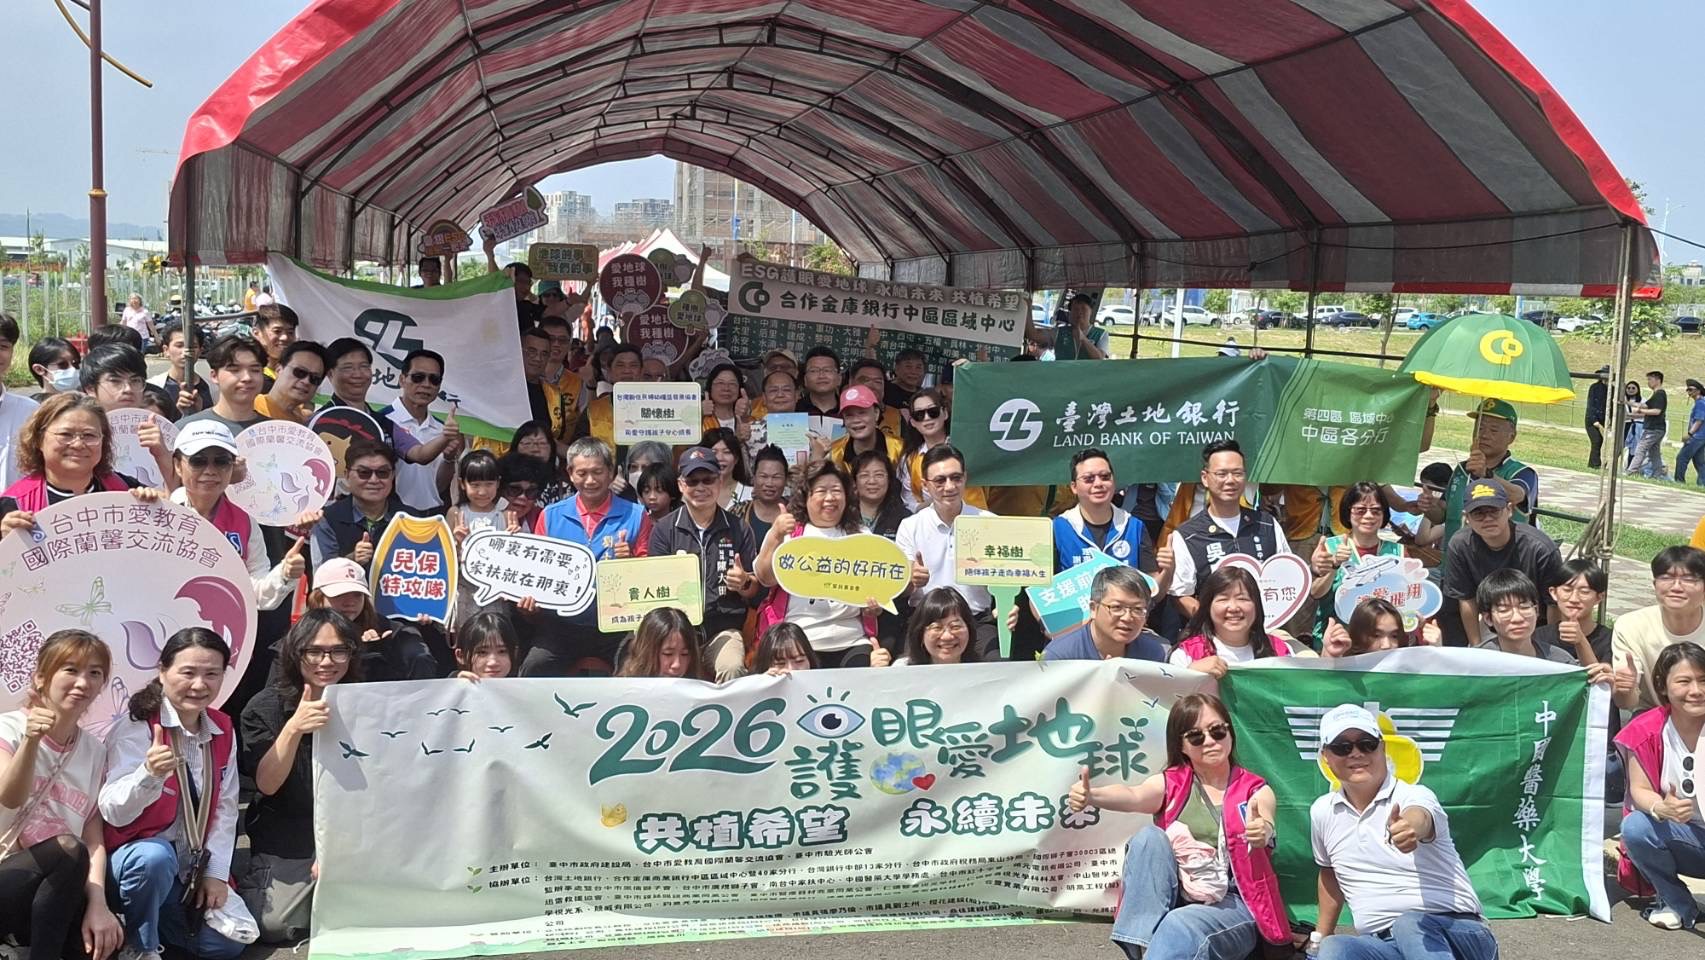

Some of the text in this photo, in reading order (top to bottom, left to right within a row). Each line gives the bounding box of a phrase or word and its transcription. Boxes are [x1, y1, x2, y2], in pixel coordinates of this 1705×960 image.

[611, 262, 646, 274] 愛地球
[612, 276, 647, 288] 我種樹
[740, 264, 1020, 312] ESG護眼愛地球 永續未來 共植希望
[779, 291, 1016, 333] 合作金庫銀行中區區域中心
[640, 327, 675, 339] 我種樹
[1055, 399, 1241, 433] 臺灣土地銀行
[1303, 407, 1343, 423] 第四區
[1053, 431, 1236, 448] LAND BANK OF TAIWAN
[1301, 424, 1390, 446] 中區各分行
[50, 503, 203, 537] 台中市愛教育
[21, 527, 224, 572] 國際蘭馨交流協會
[984, 544, 1024, 558] 幸福樹
[392, 550, 439, 575] 兒保
[778, 552, 906, 580] 做公益的好所在
[964, 568, 1047, 578] 陪伴孩子走向幸福人生
[380, 576, 446, 600] 特攻隊
[628, 586, 671, 601] 貴人樹
[611, 614, 644, 624] 成為孩子
[589, 697, 788, 787] 2026
[633, 791, 1101, 855] 共植希望 永續未來
